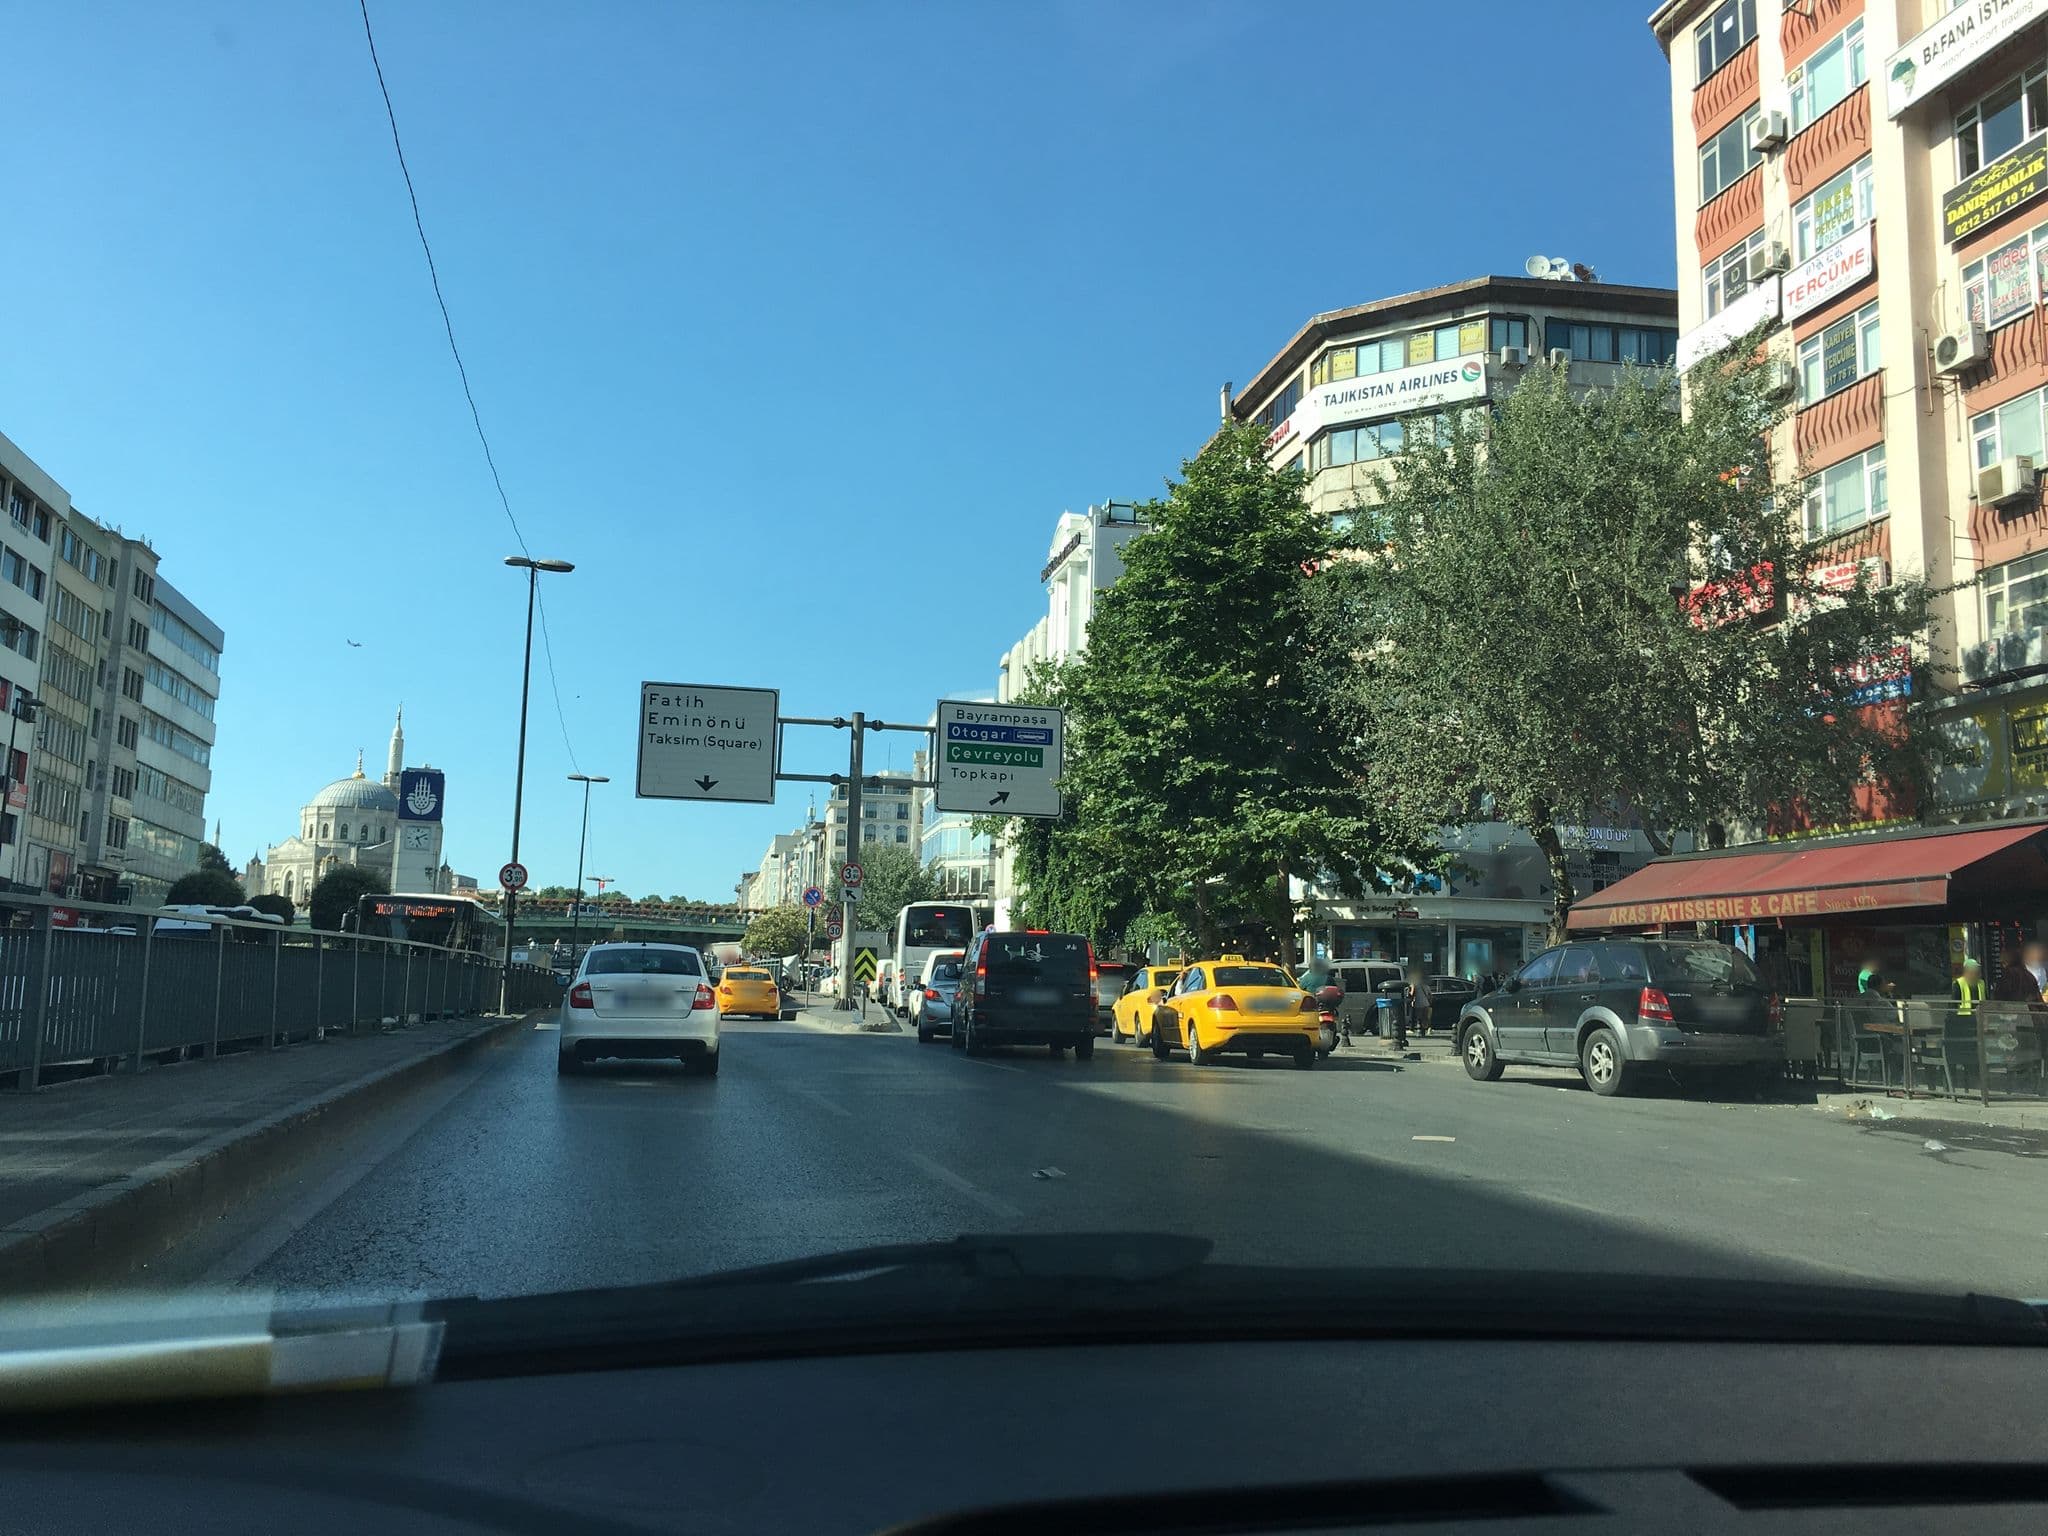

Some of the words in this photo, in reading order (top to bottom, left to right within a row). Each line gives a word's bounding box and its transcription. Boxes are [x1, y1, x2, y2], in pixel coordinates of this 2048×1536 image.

[2001, 1, 2033, 28] trading
[1923, 16, 1975, 65] BAFANA
[1947, 156, 2045, 225] DANIŞMANLIK
[1955, 214, 1980, 236] 0212
[1983, 201, 2002, 220] 517
[2005, 192, 2018, 206] 19
[2021, 182, 2034, 198] 74
[1324, 382, 1394, 408] TAJIKISTAN
[1399, 371, 1458, 393] AIRLINES
[649, 693, 704, 708] Fatih
[648, 712, 745, 730] Eminönü
[956, 709, 1047, 725] Bayrampaşa
[648, 733, 700, 746] Taksim
[703, 734, 762, 750] (Square)
[952, 726, 1006, 741] Otogar
[951, 746, 1039, 764] Çevreyolu
[951, 767, 1014, 783] Topkapı
[504, 869, 513, 882] 3
[845, 868, 852, 879] 3
[1608, 906, 1648, 924] ARAS
[1651, 899, 1746, 921] PATISSERIE
[1751, 899, 1763, 916] &
[1768, 893, 1818, 914] CAFE
[1825, 898, 1851, 911] Since
[1852, 895, 1878, 909] 1976
